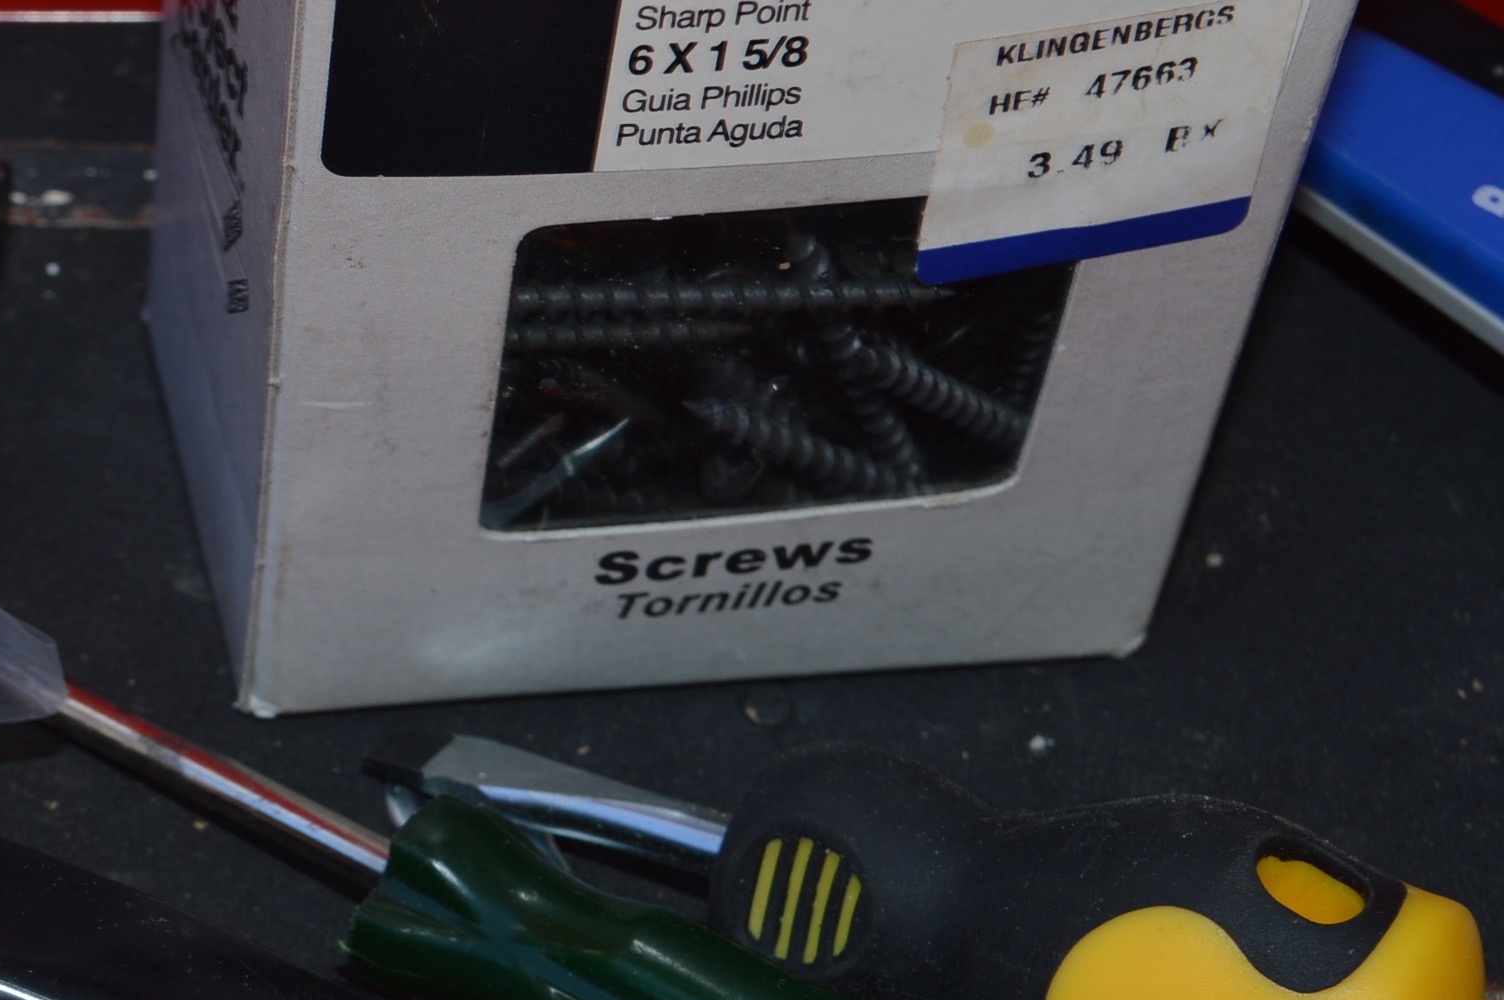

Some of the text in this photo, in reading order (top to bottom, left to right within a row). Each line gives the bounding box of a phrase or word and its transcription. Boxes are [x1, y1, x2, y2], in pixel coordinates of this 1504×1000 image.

[635, 0, 812, 33] Sharp Point
[995, 5, 1236, 67] KLINGENBERGS
[628, 35, 810, 76] 6 X 1 5/8
[1084, 56, 1199, 99] 47663
[622, 83, 802, 113] Guia Phillips
[615, 115, 803, 148] Punta Aguda
[1027, 139, 1124, 179] 3.49
[594, 537, 873, 586] Screws
[616, 580, 843, 619] Tornillos
